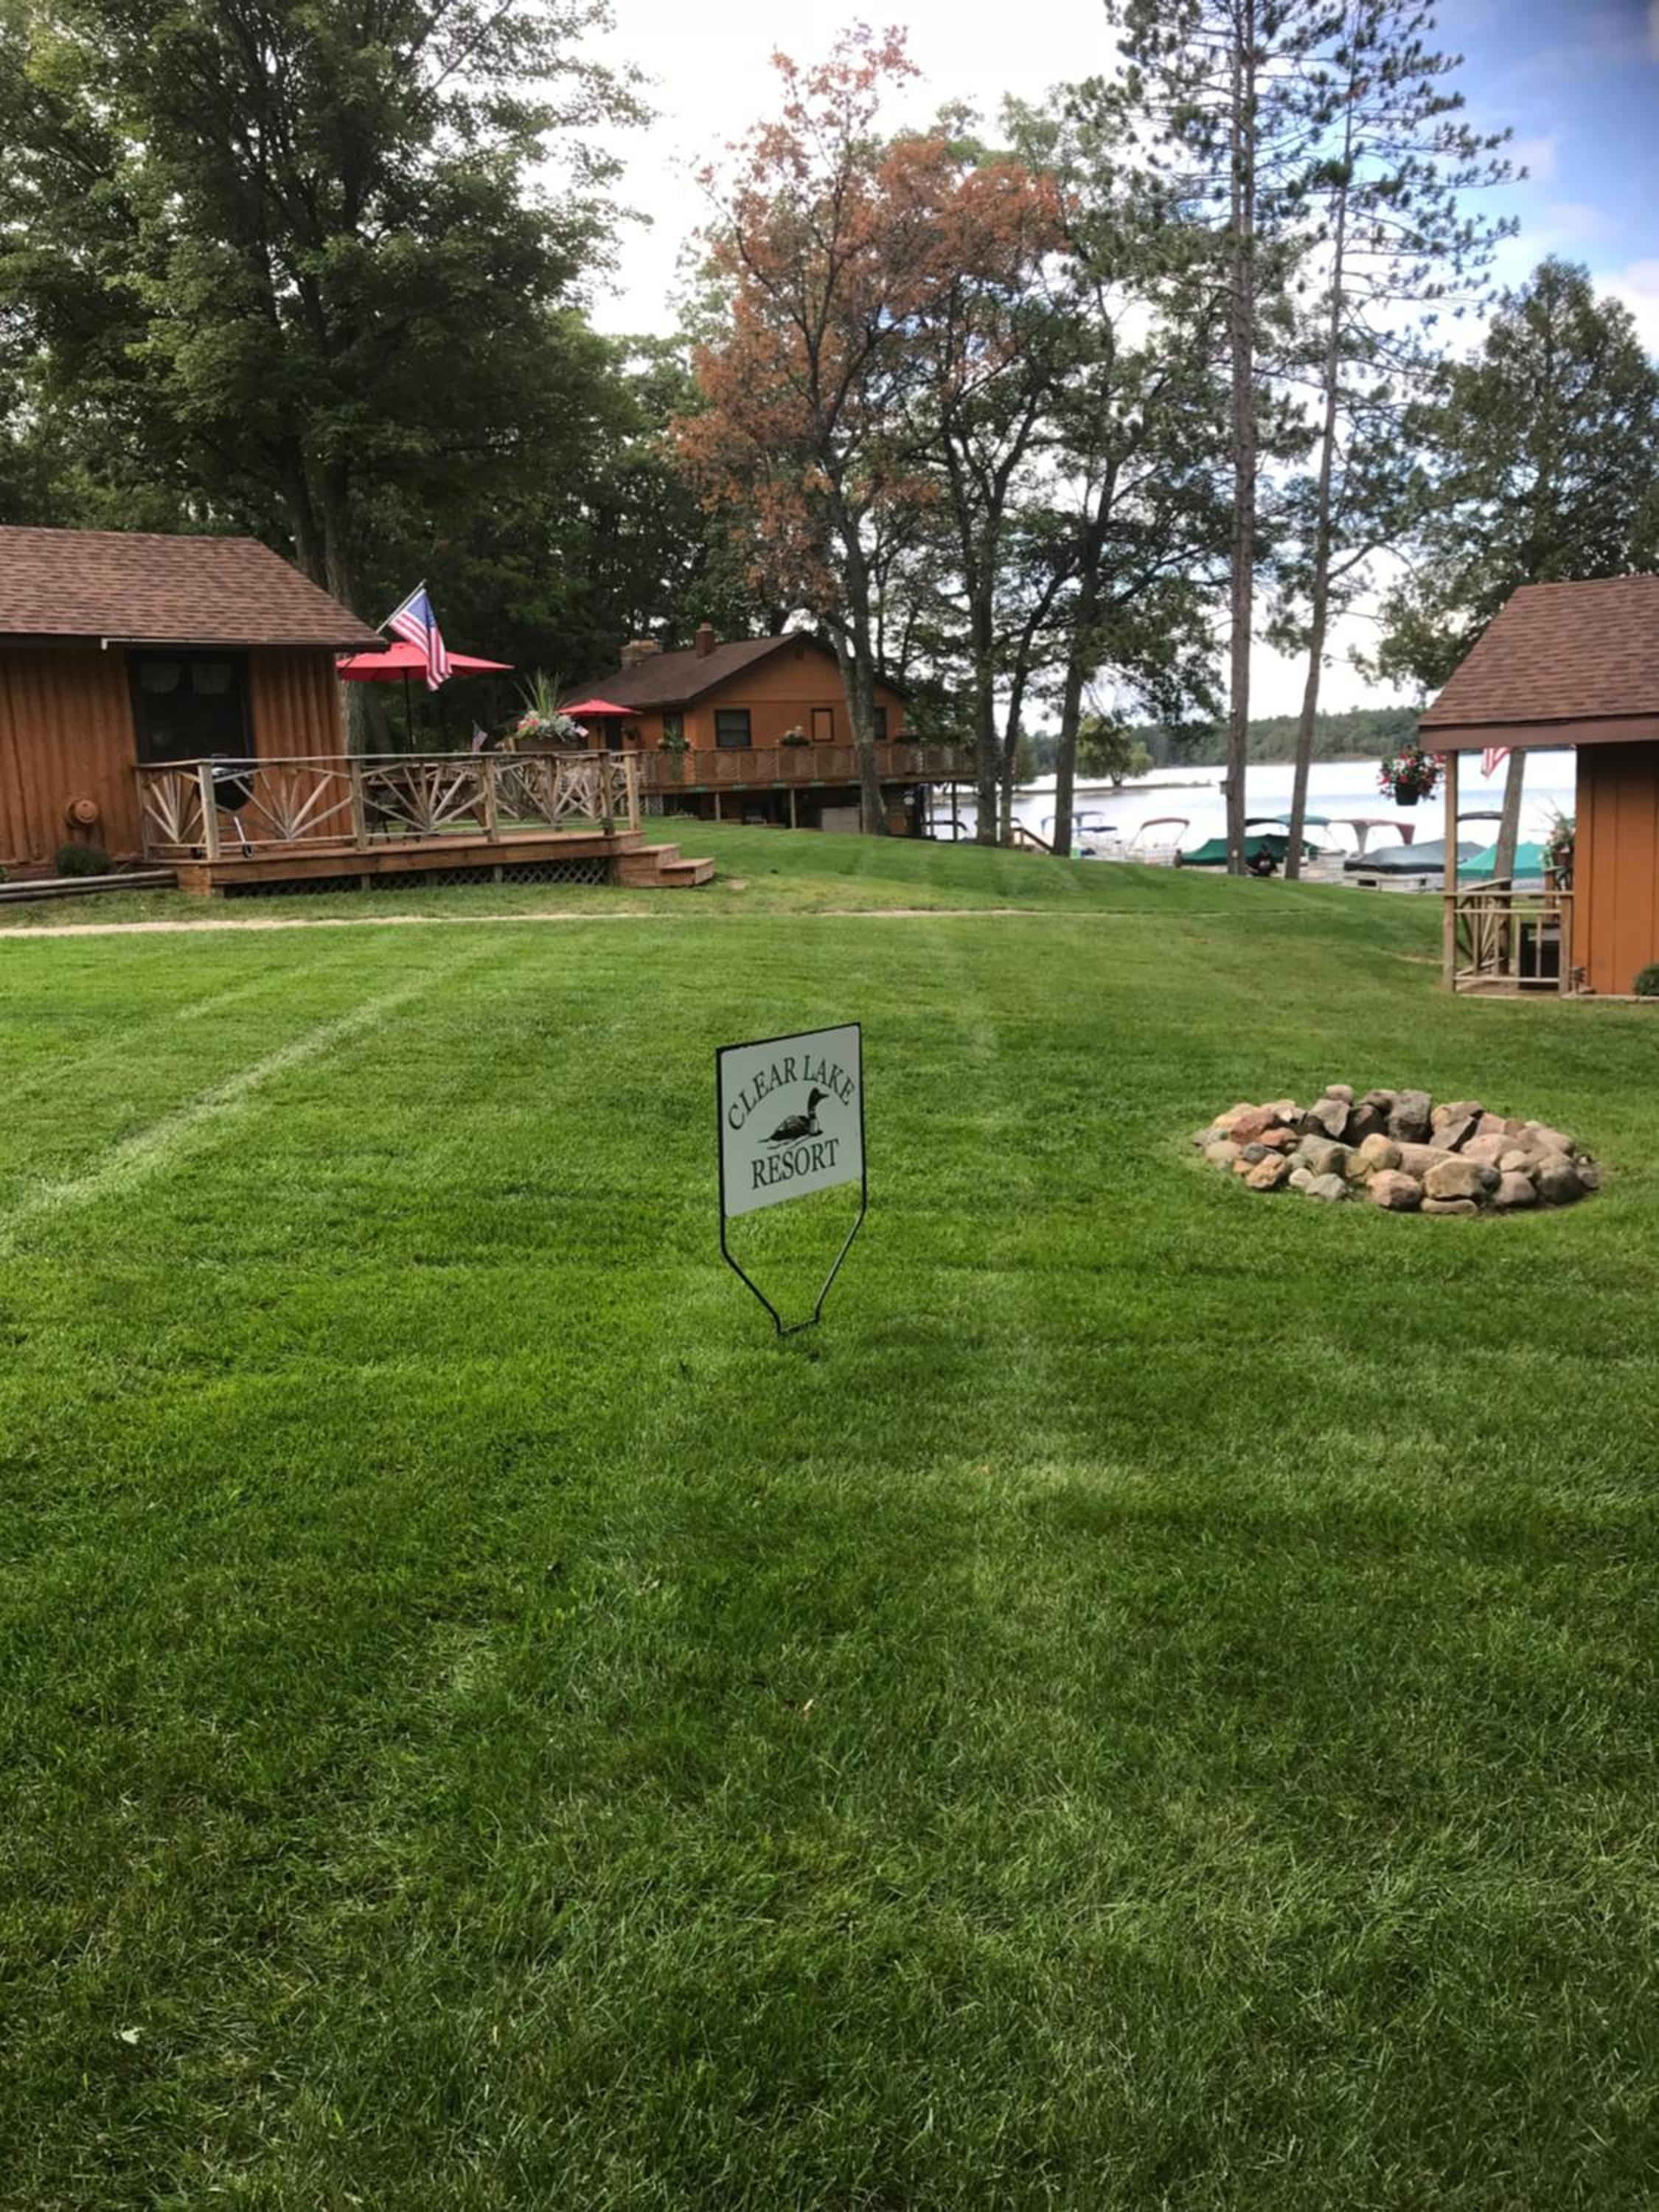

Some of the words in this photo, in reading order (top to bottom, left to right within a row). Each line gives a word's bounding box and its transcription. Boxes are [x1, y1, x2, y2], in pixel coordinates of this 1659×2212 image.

[728, 1056, 797, 1130] CLEAR
[802, 1054, 855, 1106] LAKE
[751, 1138, 839, 1190] RESORT
